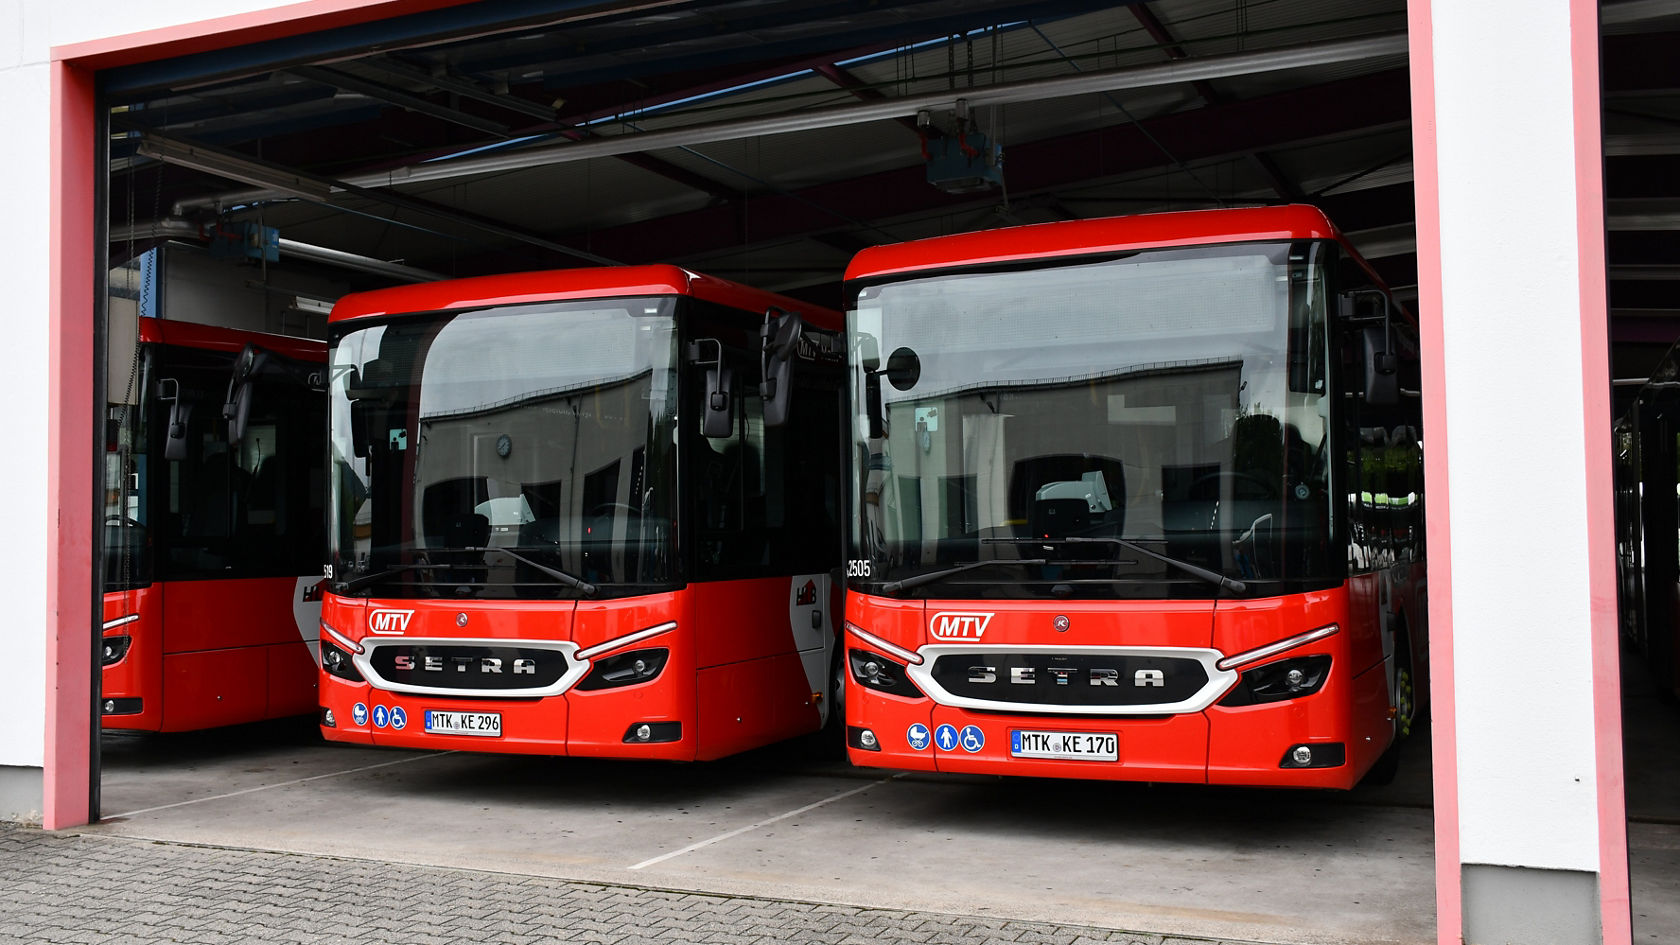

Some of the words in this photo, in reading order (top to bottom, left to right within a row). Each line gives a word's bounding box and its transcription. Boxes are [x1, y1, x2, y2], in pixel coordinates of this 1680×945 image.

[374, 611, 415, 631] MTV
[937, 614, 994, 638] MTV
[394, 655, 537, 675] SETRA
[968, 665, 1165, 688] SETRA
[432, 713, 453, 728] MTK
[461, 714, 475, 729] KE
[478, 715, 499, 730] 296
[1022, 733, 1051, 751] MTK
[1062, 735, 1082, 752] KE
[1086, 737, 1115, 753] 170
